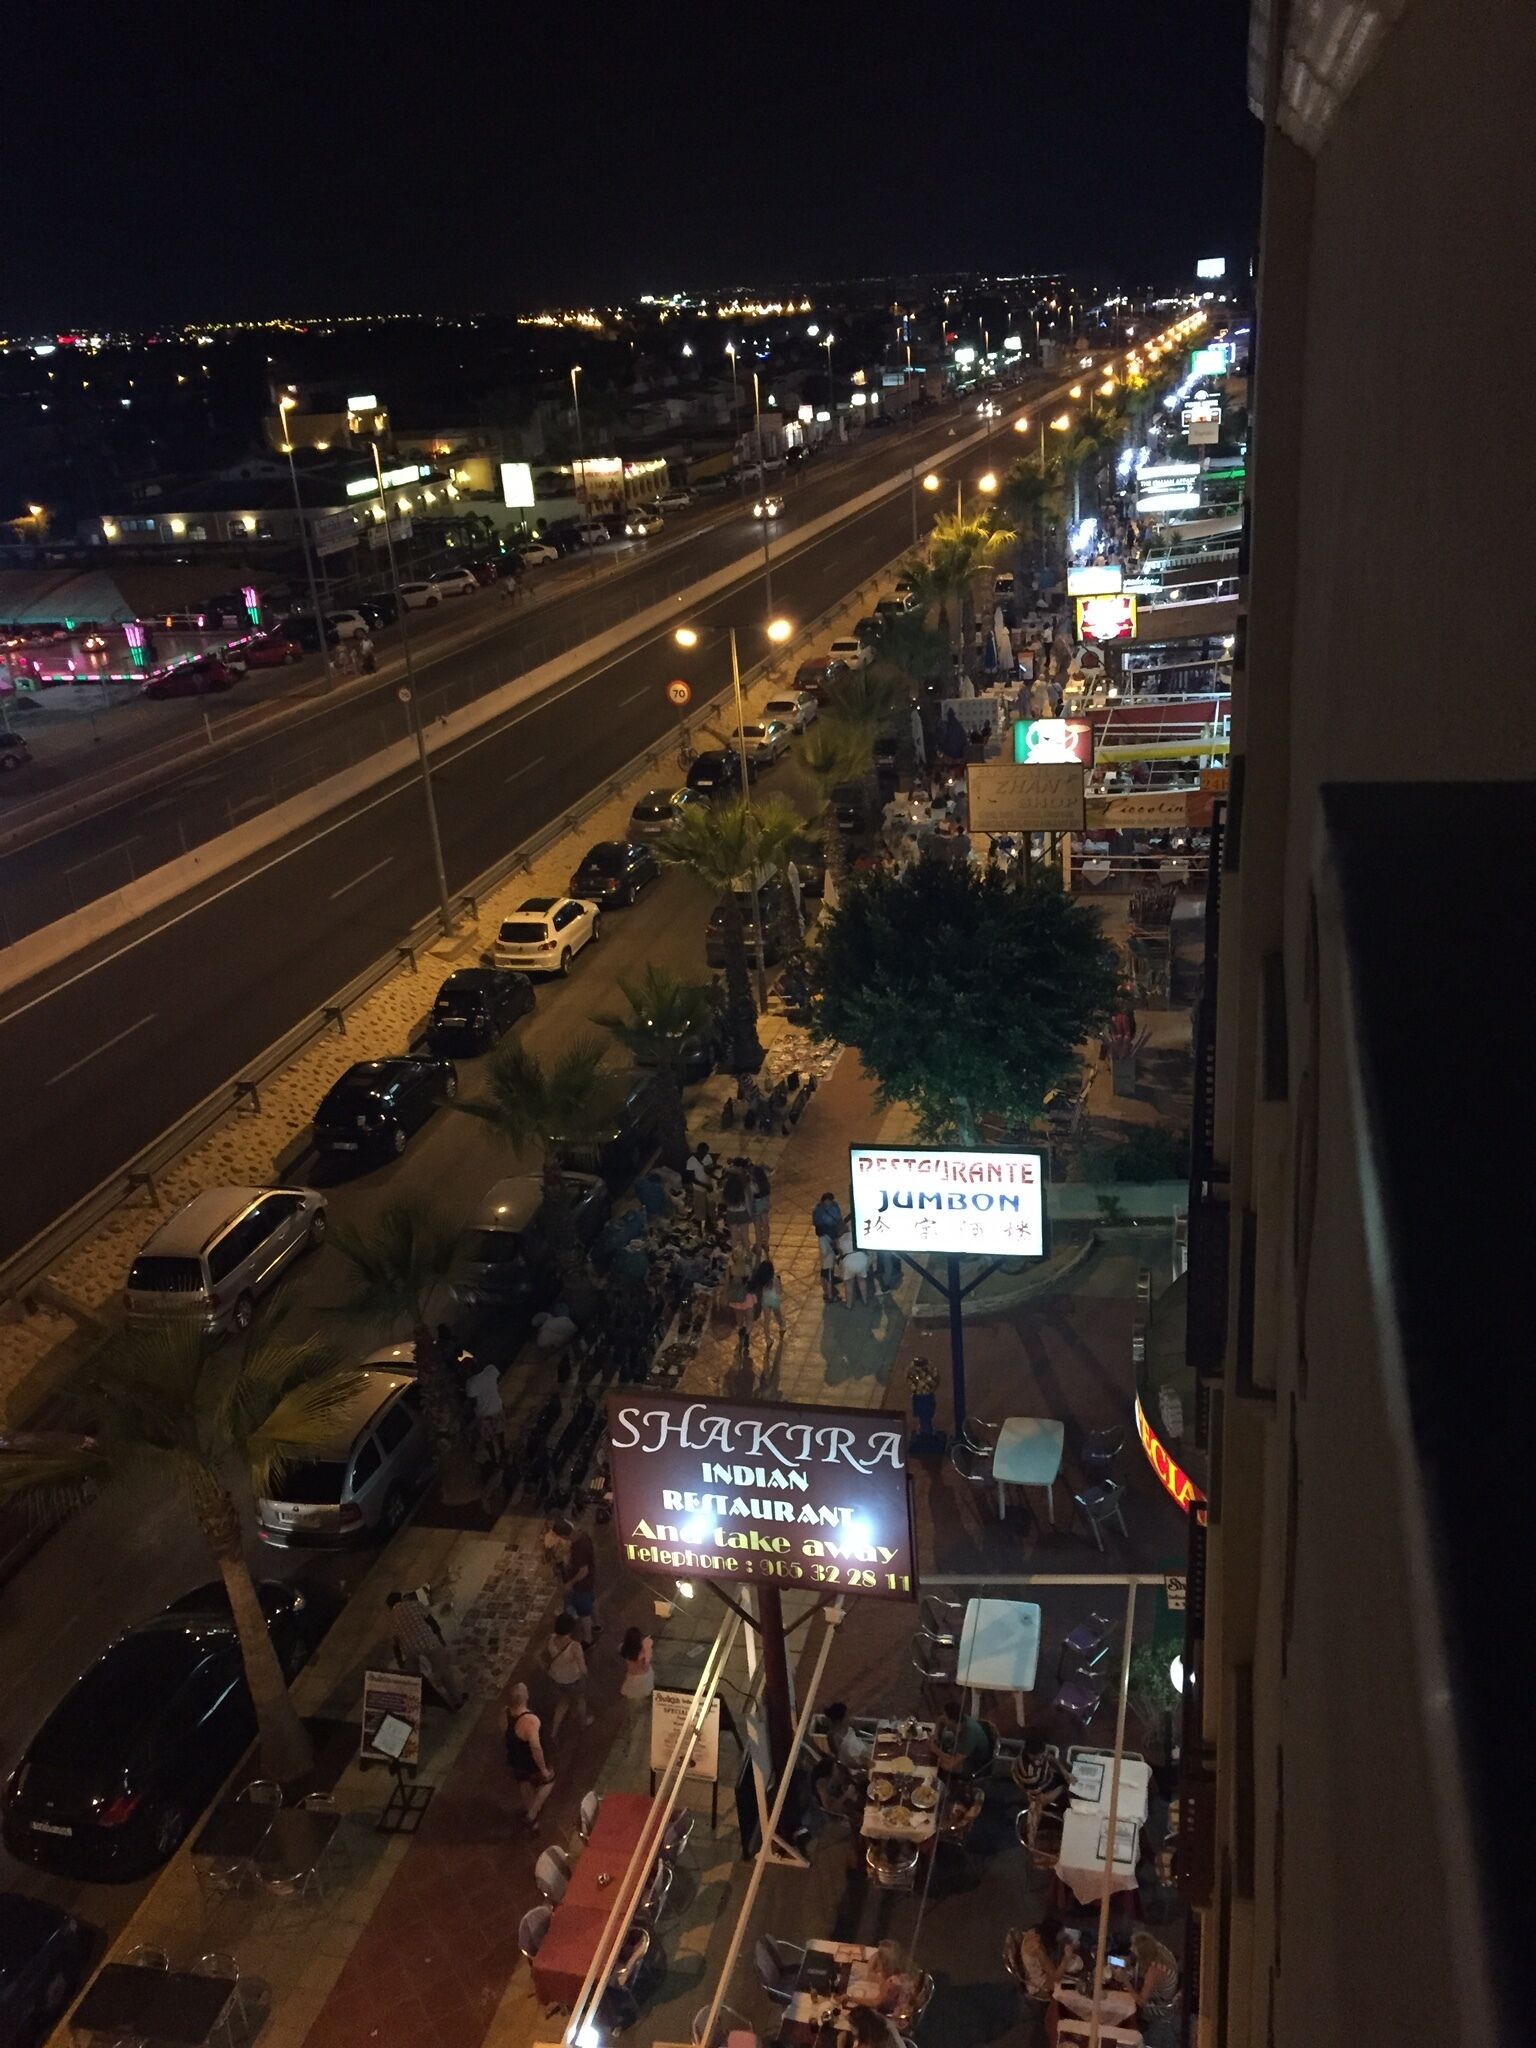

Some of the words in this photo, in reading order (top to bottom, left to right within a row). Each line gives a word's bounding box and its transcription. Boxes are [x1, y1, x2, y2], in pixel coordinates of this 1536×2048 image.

[672, 689, 686, 699] 70
[877, 1189, 1020, 1213] JUMBON
[611, 1403, 905, 1475] SHAKIRA
[701, 1462, 809, 1492] INDIAN
[662, 1489, 856, 1529] RESTAURANT
[713, 1526, 791, 1555] take
[802, 1537, 899, 1565] away
[624, 1543, 738, 1572] Telephone
[759, 1558, 804, 1580] 965
[810, 1562, 841, 1584] 32
[846, 1567, 877, 1588] 28
[884, 1573, 910, 1593] 11
